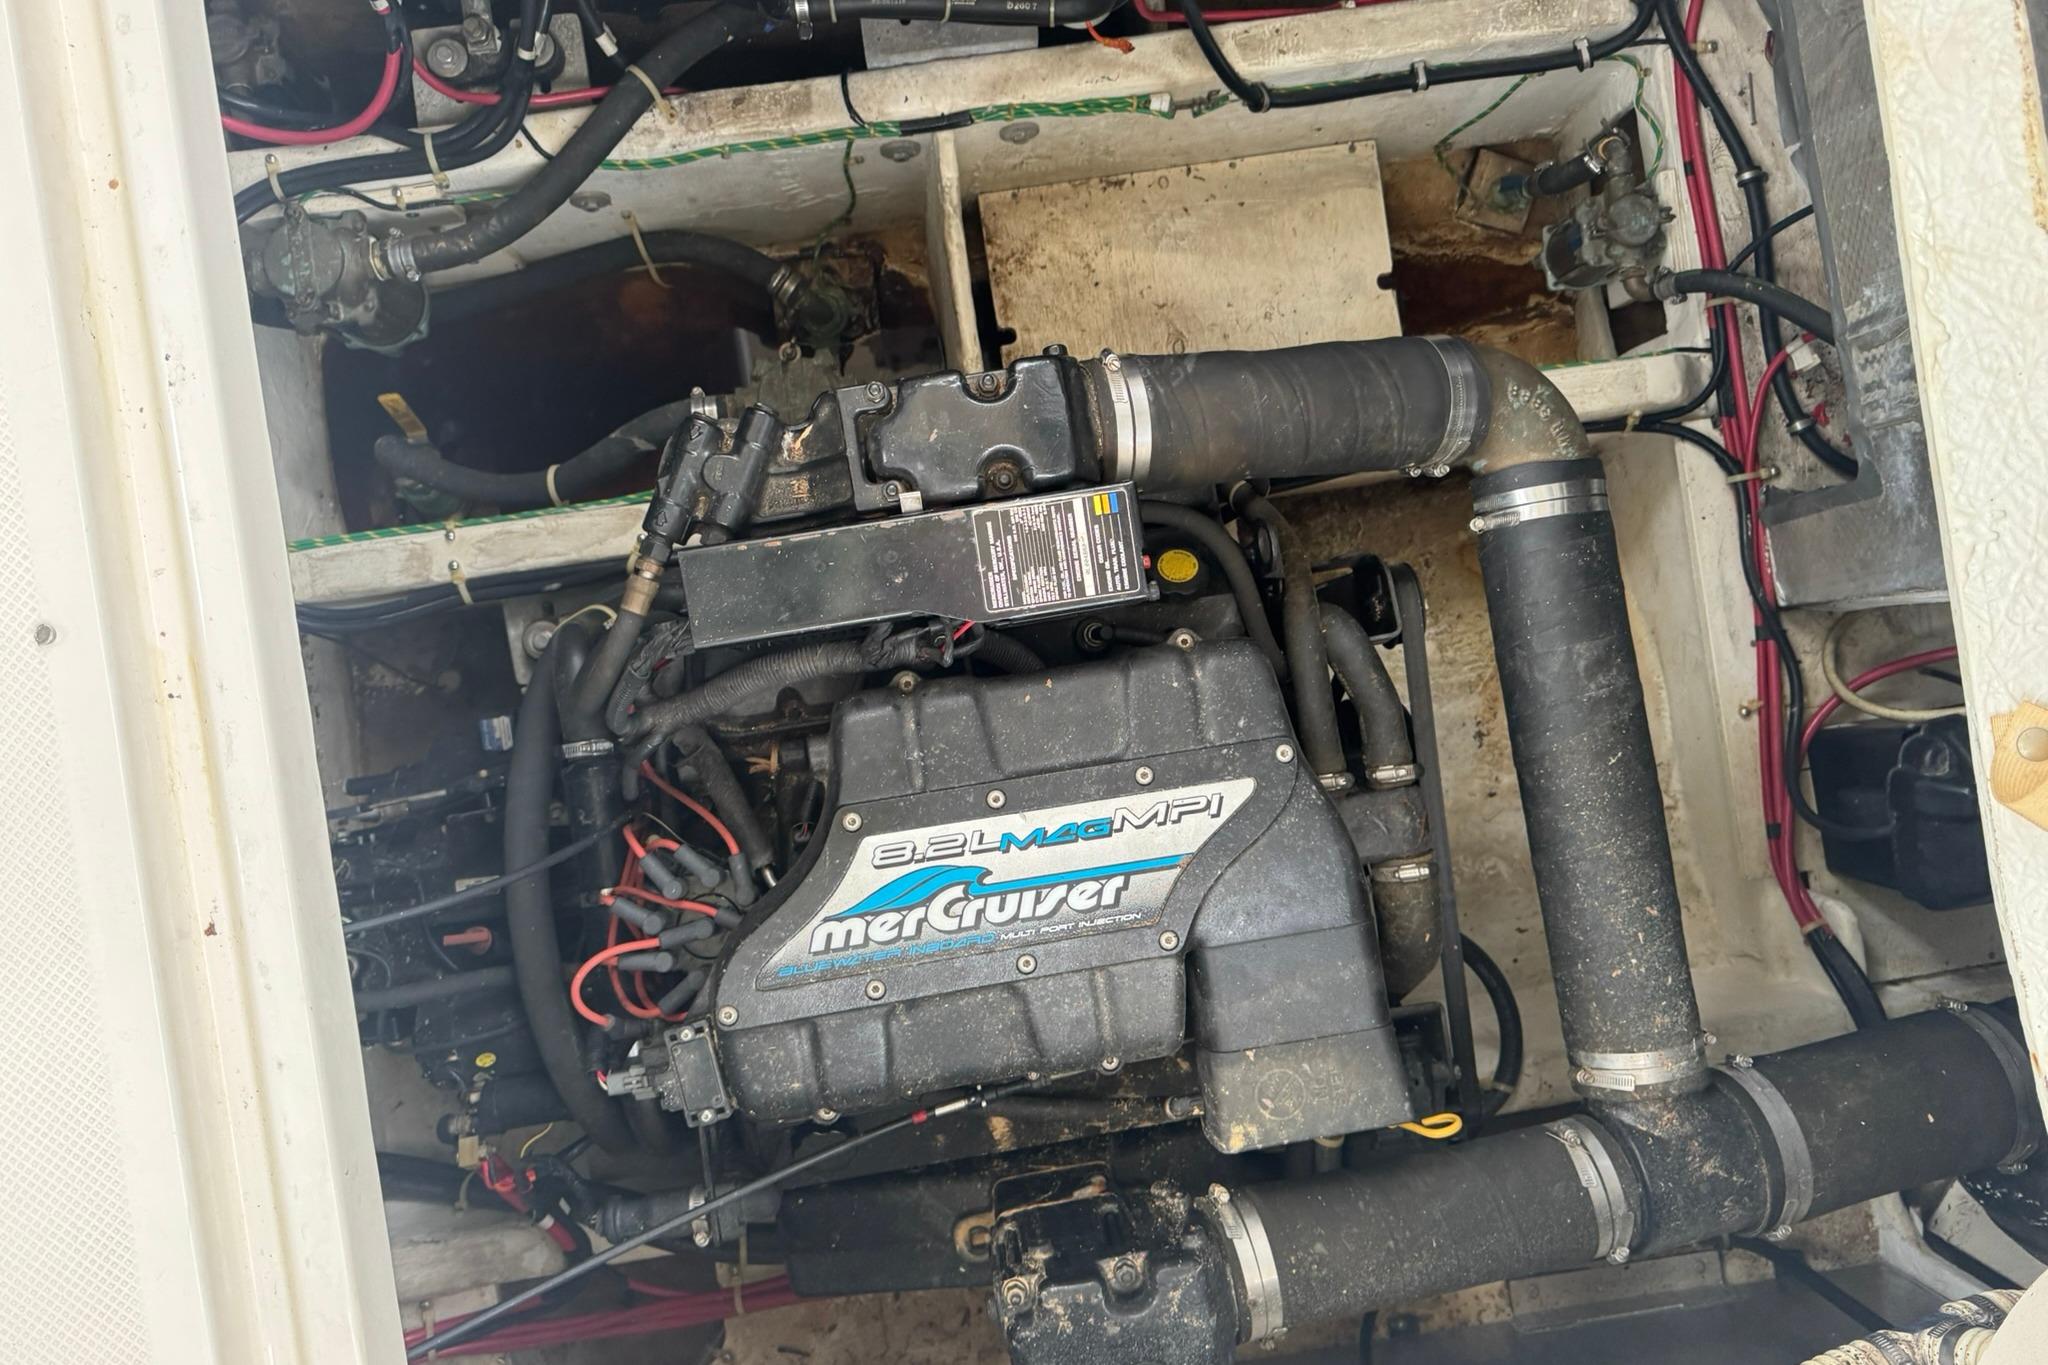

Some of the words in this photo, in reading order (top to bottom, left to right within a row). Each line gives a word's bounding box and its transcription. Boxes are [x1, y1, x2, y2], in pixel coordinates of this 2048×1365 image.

[907, 932, 997, 956] INBOARD
[1000, 929, 1036, 941] MULTI
[1040, 924, 1075, 935] PORT
[1078, 912, 1142, 927] INJECTION
